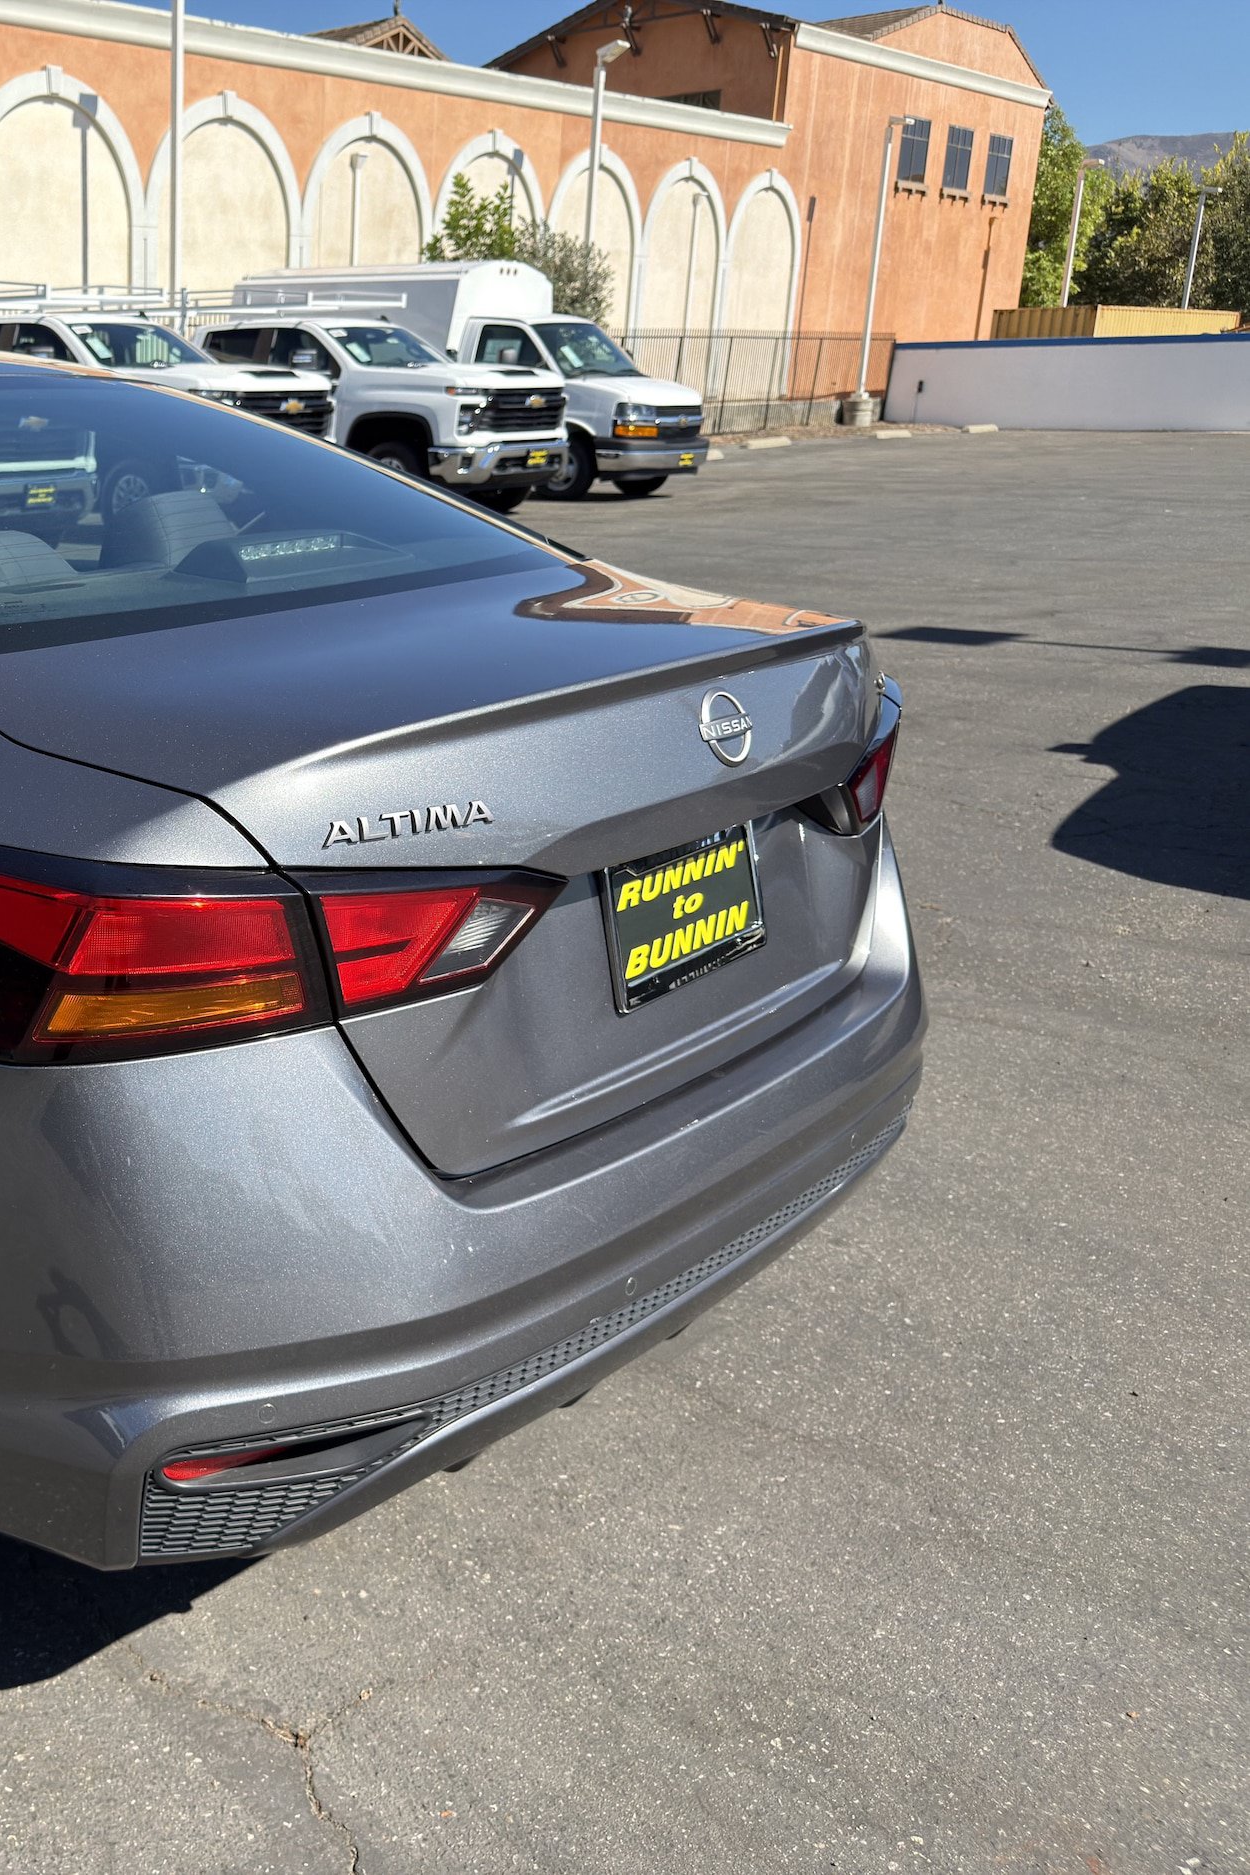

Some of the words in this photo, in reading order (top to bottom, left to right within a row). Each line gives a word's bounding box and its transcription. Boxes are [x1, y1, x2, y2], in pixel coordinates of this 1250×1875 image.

[700, 716, 753, 739] NISSAN
[322, 800, 495, 849] ALTIMA
[616, 839, 745, 912] RUNNIN'
[672, 892, 705, 920] to
[625, 900, 750, 979] BUNNIN
